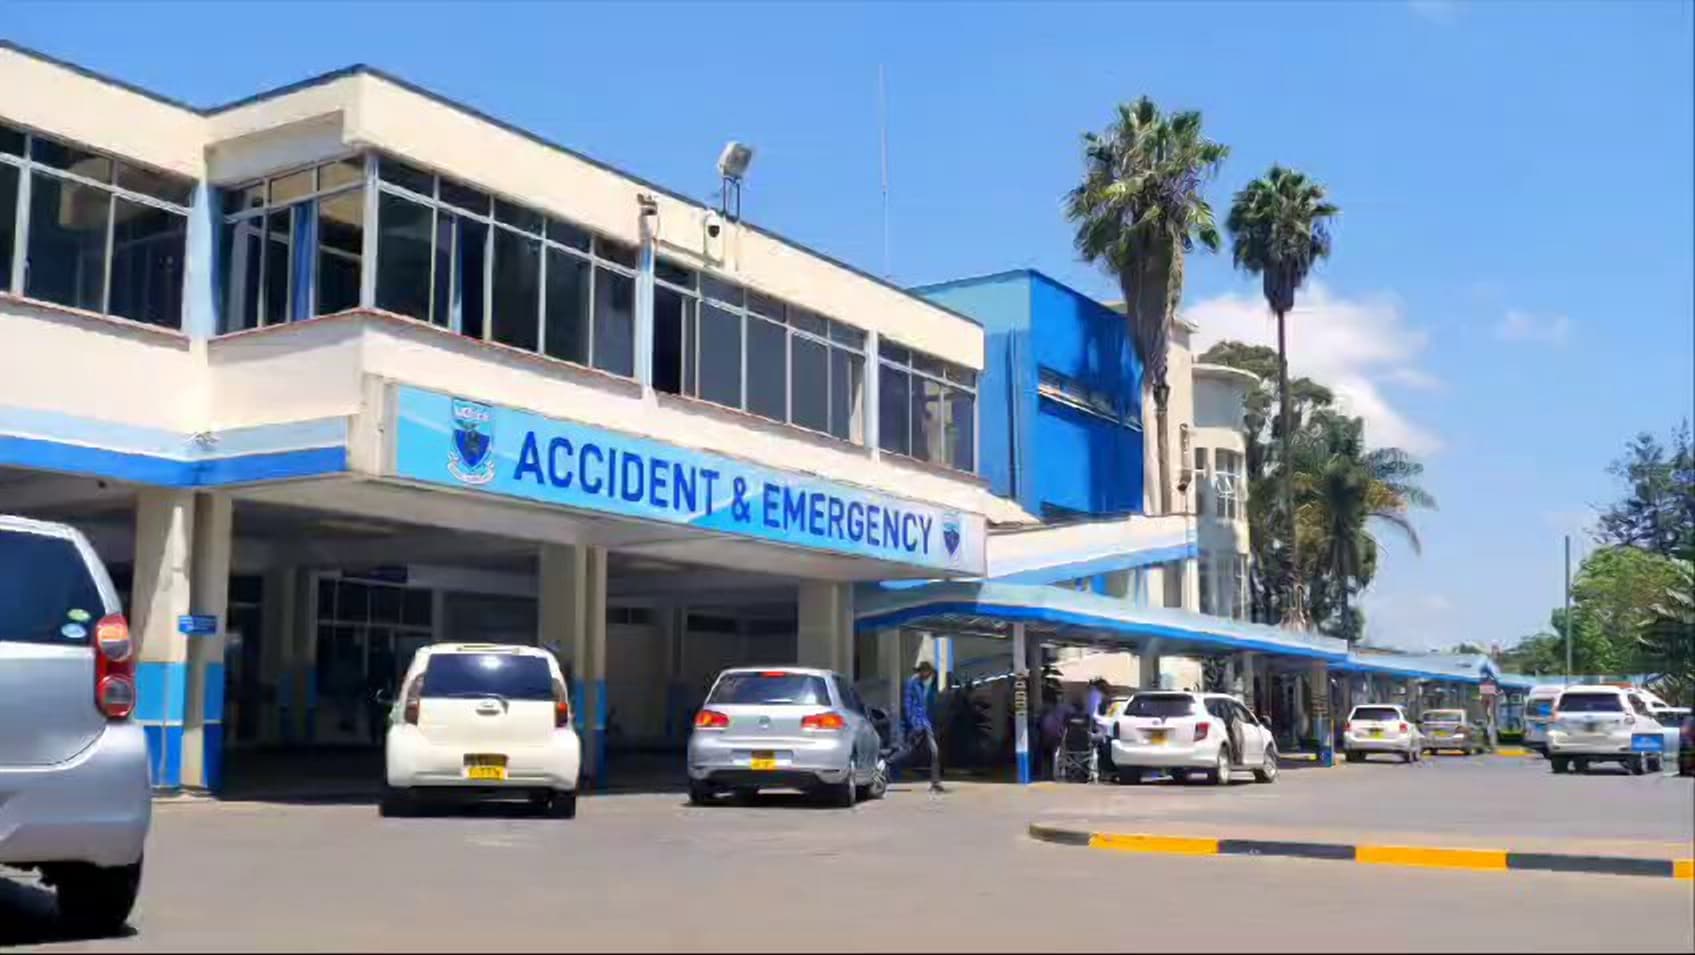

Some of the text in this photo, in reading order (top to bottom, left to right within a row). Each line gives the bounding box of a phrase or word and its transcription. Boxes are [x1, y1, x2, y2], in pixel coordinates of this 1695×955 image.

[514, 431, 933, 555] ACCIDENT & EMERGENCY
